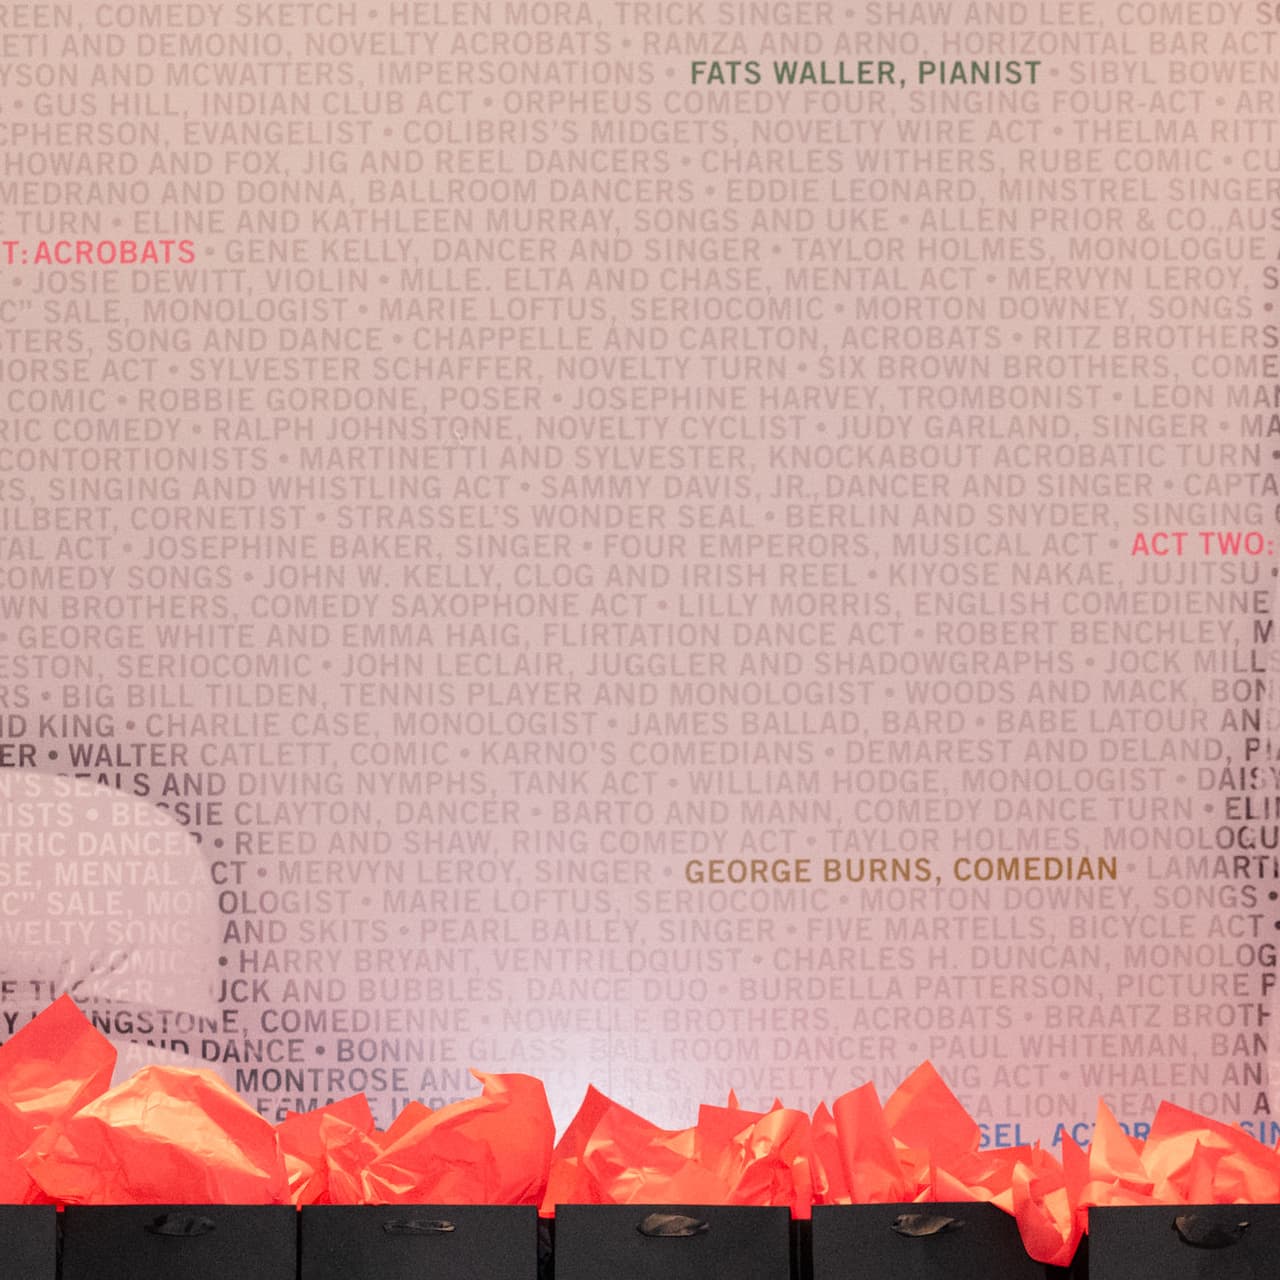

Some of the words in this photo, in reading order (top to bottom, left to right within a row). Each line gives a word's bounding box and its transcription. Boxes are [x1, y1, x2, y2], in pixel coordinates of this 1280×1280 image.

[95, 3, 223, 29] COMEDY
[235, 2, 357, 28] SKETCH
[691, 60, 762, 85] FATS
[772, 60, 906, 86] WALLER,
[918, 60, 1042, 85] PIANIST
[368, 178, 537, 204] BALLROOM
[549, 178, 695, 204] DANCERS
[43, 298, 130, 325] SALE,
[143, 297, 344, 323] MONOLOGIST
[106, 328, 192, 353] SONG
[202, 327, 268, 353] AND
[279, 327, 383, 352] DANCE
[142, 535, 318, 561] JOSEPHINE
[329, 534, 433, 560] BAKER,
[455, 533, 572, 559] SINGER
[1130, 531, 1189, 557] ACT
[1198, 531, 1274, 556] TWO:
[935, 620, 1059, 646] ROBERT
[38, 714, 115, 739] KING
[68, 743, 187, 768] WALTER
[684, 858, 812, 884] GEORGE
[823, 857, 942, 884] BURNS,
[953, 856, 1118, 882] COMEDIAN
[807, 915, 872, 940] FIVE
[1069, 915, 1196, 940] BICYCLE
[1209, 915, 1265, 940] ACT
